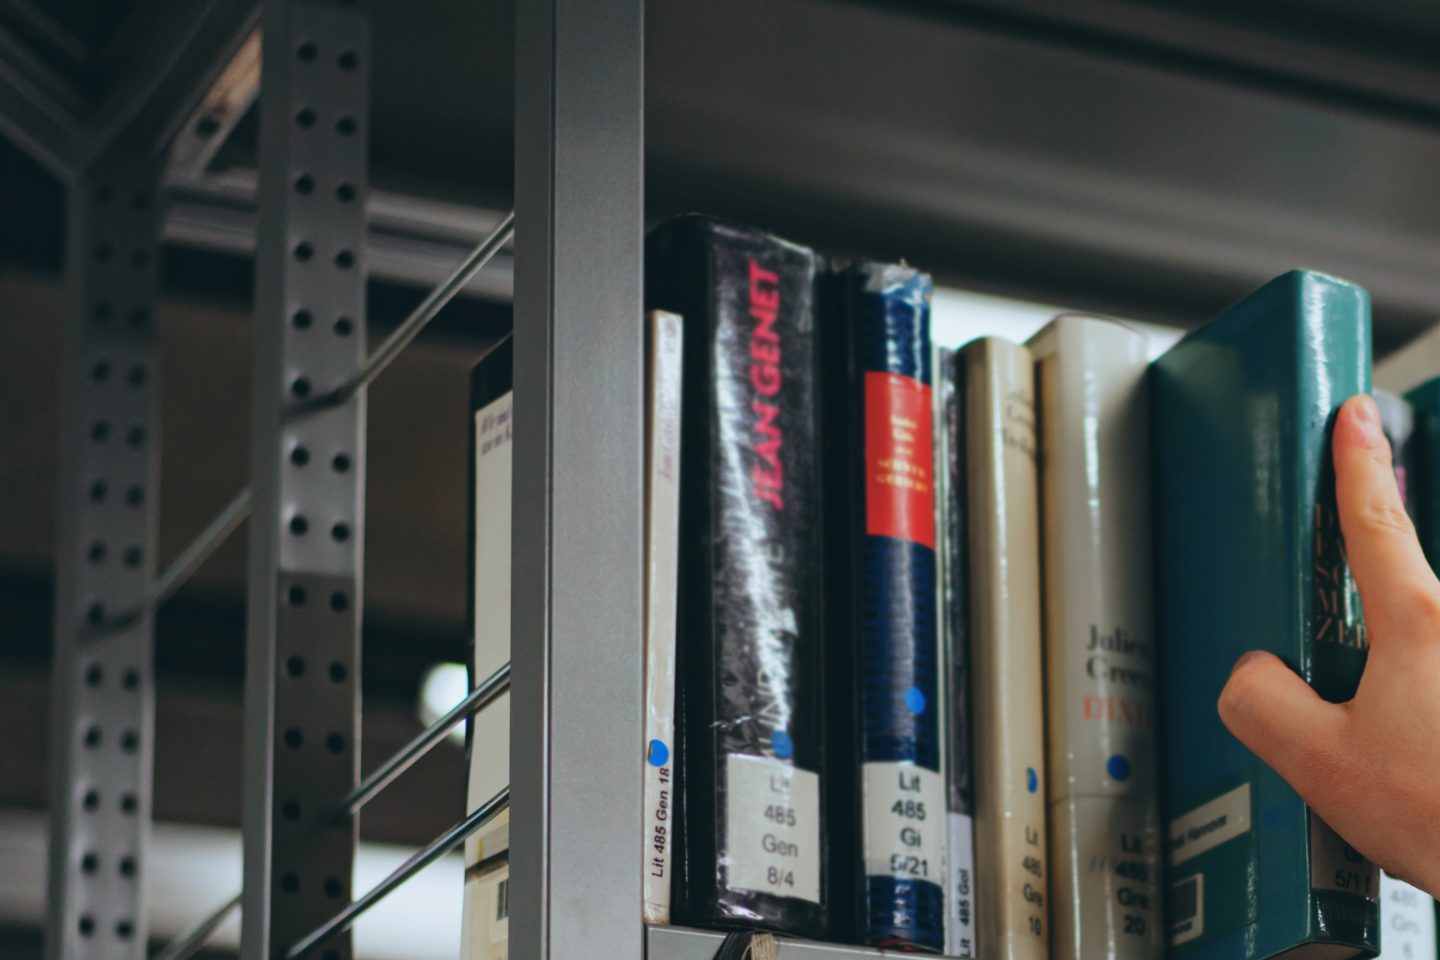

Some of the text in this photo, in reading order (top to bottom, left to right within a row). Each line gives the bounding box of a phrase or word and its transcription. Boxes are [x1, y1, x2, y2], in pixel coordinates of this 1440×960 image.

[748, 260, 783, 397] GENET
[751, 402, 784, 511] JEAN
[899, 773, 922, 793] Lit
[652, 768, 671, 878] Lit 485 Gen 18
[764, 806, 797, 827] 485
[891, 800, 926, 822] 485
[762, 833, 798, 858] Gen
[901, 827, 922, 847] Gi
[767, 866, 795, 888] 8/4
[960, 869, 970, 896] Gol
[960, 900, 970, 926] 485
